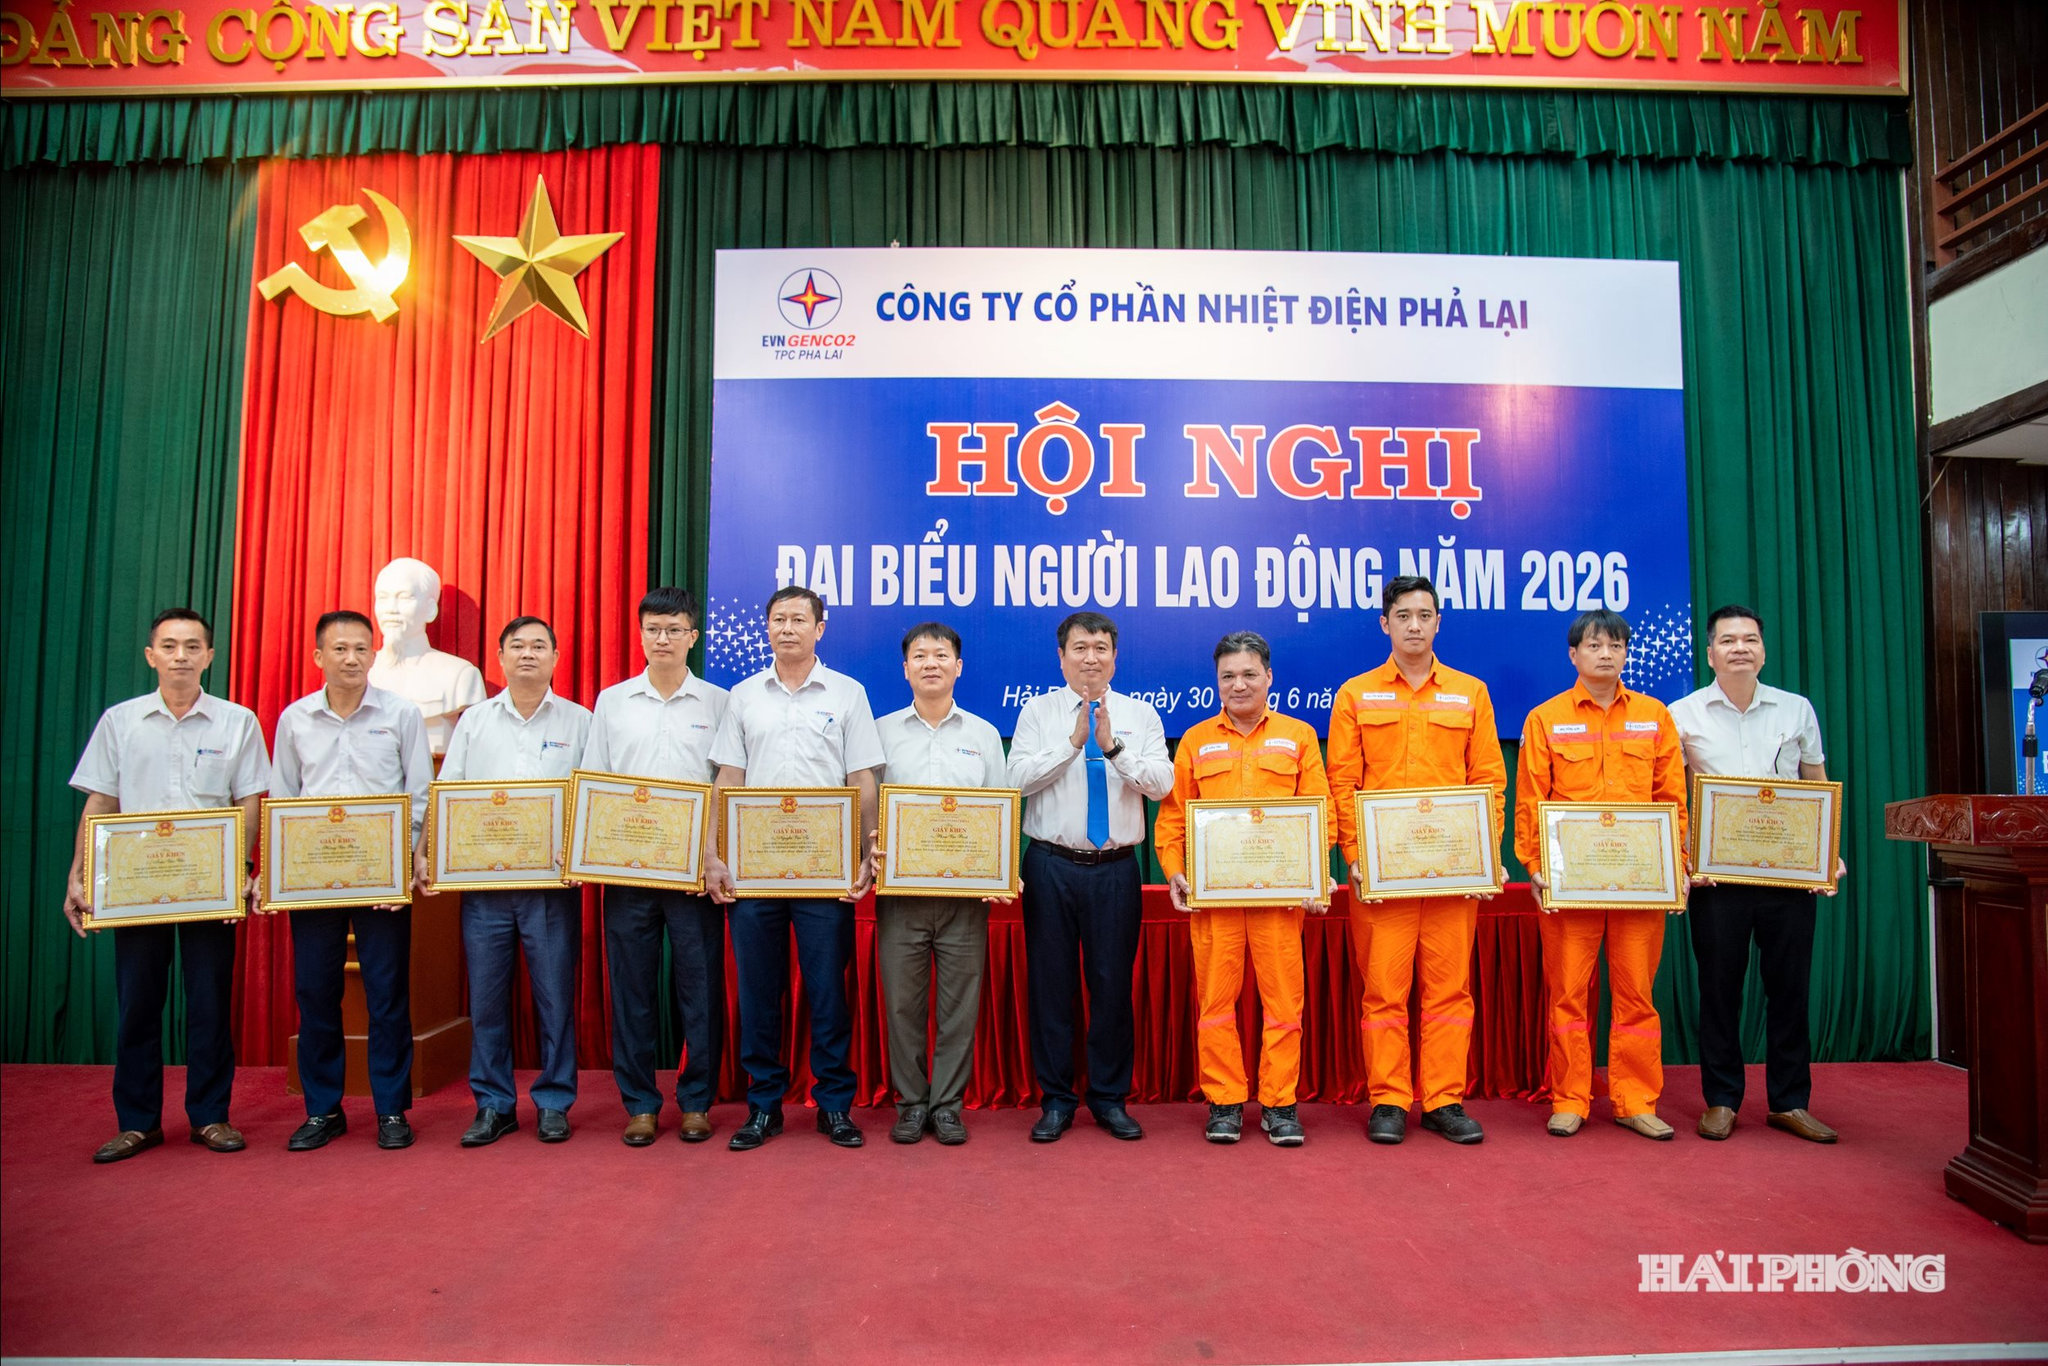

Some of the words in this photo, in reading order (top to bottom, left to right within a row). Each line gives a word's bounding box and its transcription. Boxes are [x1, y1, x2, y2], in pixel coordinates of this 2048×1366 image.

[787, 0, 962, 48] NAM
[981, 0, 1243, 60] QUANG
[1257, 0, 1453, 54] VINH
[876, 282, 970, 321] CÔNG
[981, 291, 1023, 321] TY
[1034, 279, 1078, 321] CỔ
[1090, 281, 1186, 323] PHẦN
[1198, 286, 1299, 333] NHIỆT
[1308, 287, 1387, 334] ĐIỆN
[1399, 287, 1468, 328] PHẢ
[1479, 299, 1528, 338] LẠI
[774, 349, 796, 360] TPC
[798, 350, 822, 360] PHA
[825, 350, 843, 360] LAI
[926, 400, 1146, 516] HỘI
[1184, 424, 1482, 520] NGHỊ
[775, 544, 855, 621] ĐẠI
[870, 518, 977, 607] BIỂU
[993, 530, 1138, 608] NGƯỜI
[1155, 546, 1240, 609] LAO
[1254, 533, 1383, 622] ĐỘNG
[1398, 535, 1505, 610] NĂM
[1520, 551, 1630, 612] 2026
[1187, 687, 1214, 709] 30
[1288, 687, 1301, 709] 6
[1306, 687, 1336, 709] nă
